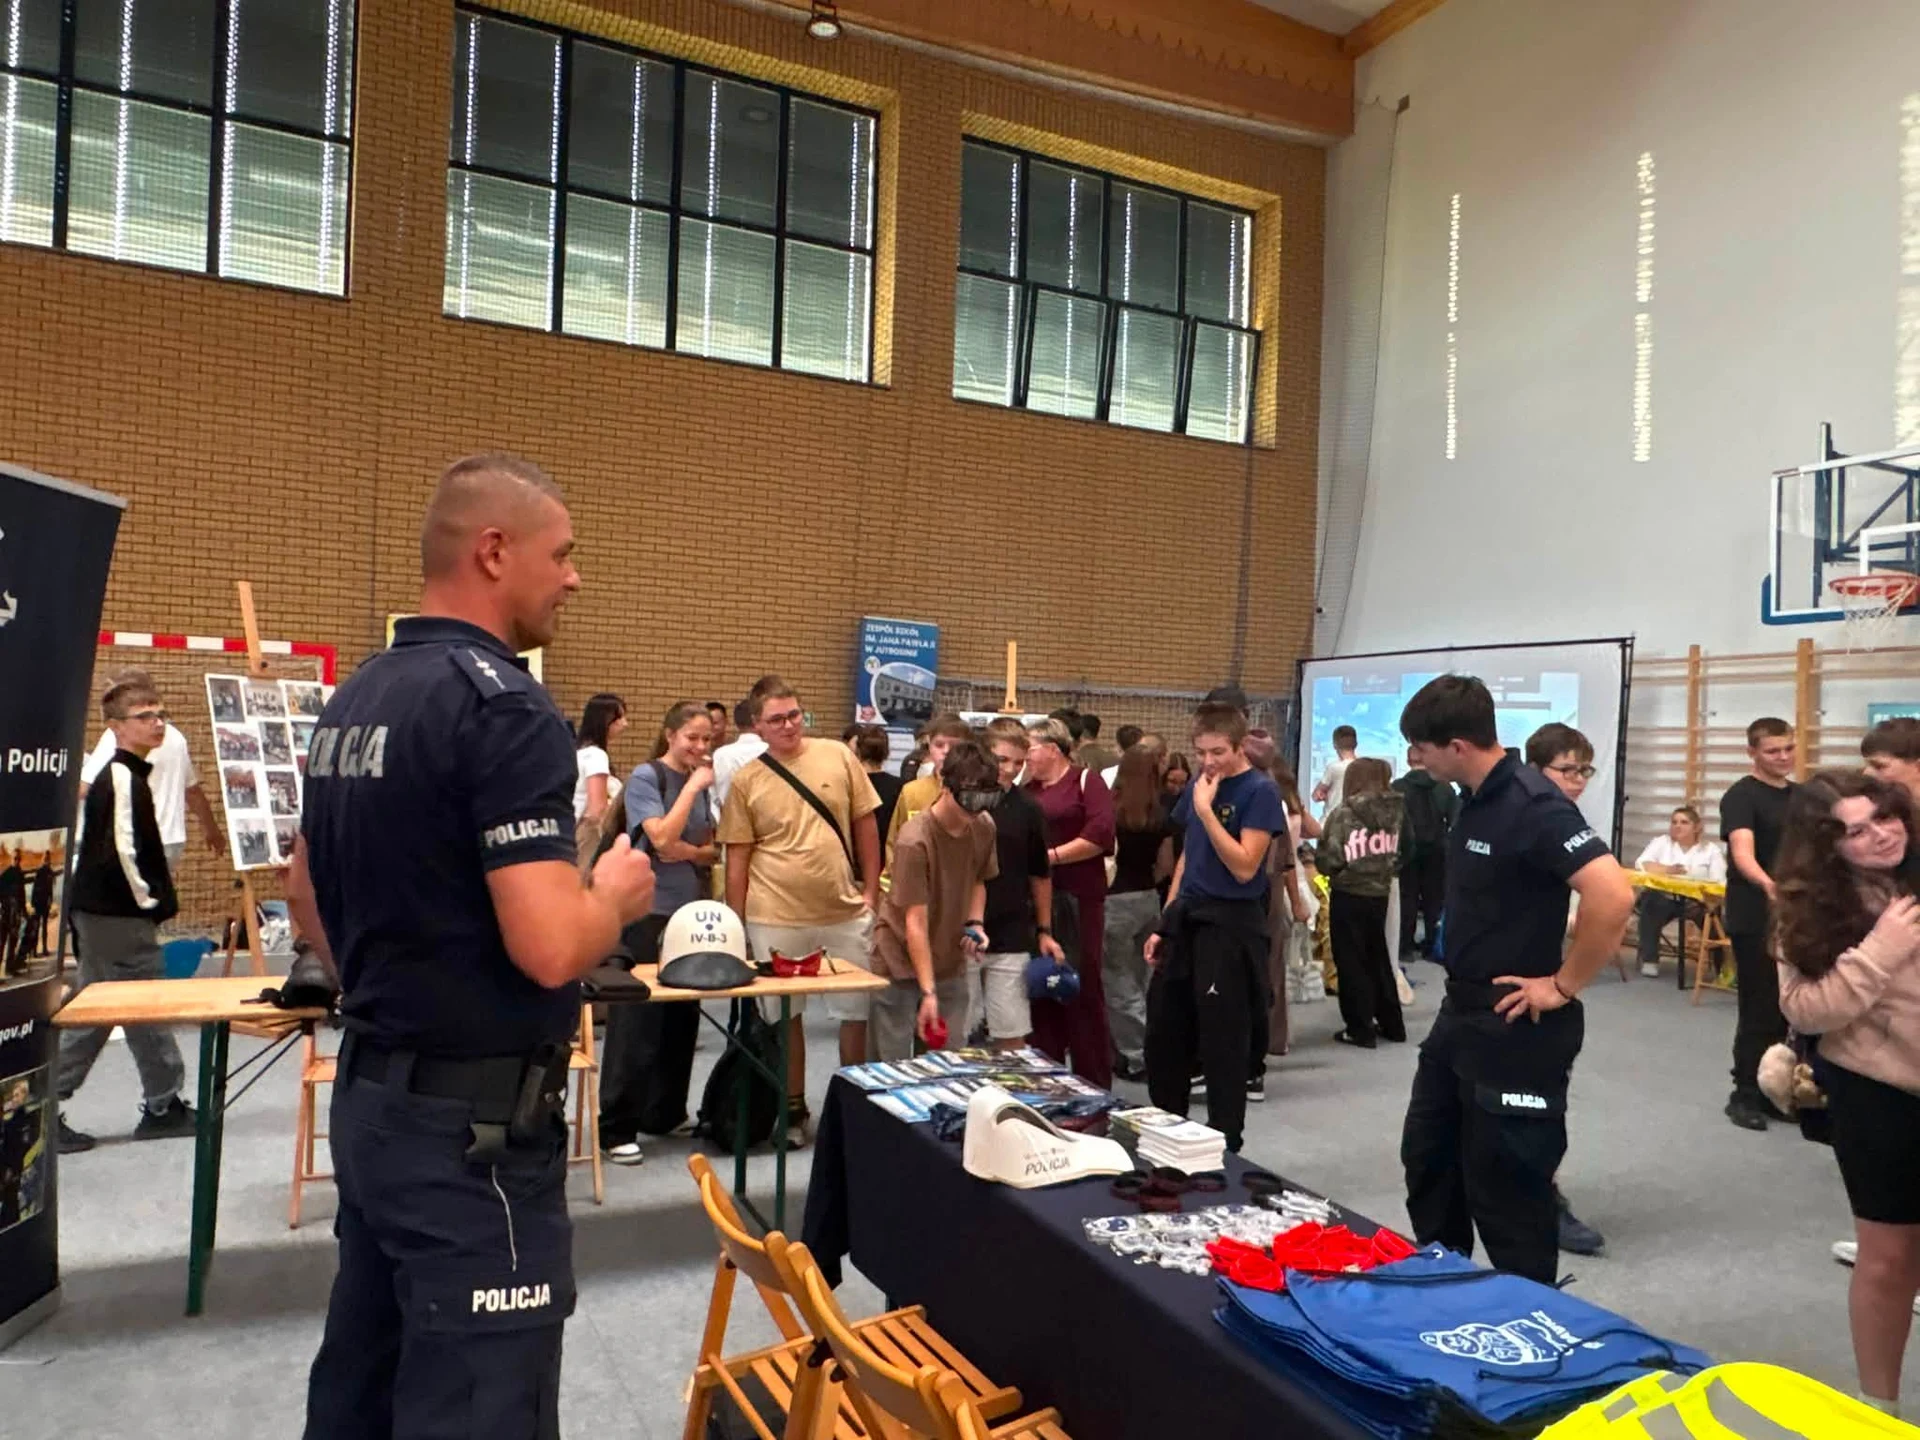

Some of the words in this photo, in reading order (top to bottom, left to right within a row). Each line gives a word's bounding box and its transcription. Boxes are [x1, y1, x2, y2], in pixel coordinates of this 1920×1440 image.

[864, 644, 873, 653] W
[879, 636, 900, 645] JANA
[8, 747, 68, 778] Policji
[484, 817, 560, 848] POLICJA
[694, 911, 722, 923] UN
[1501, 1092, 1547, 1110] POLICJA
[472, 1283, 551, 1313] POLICJA
